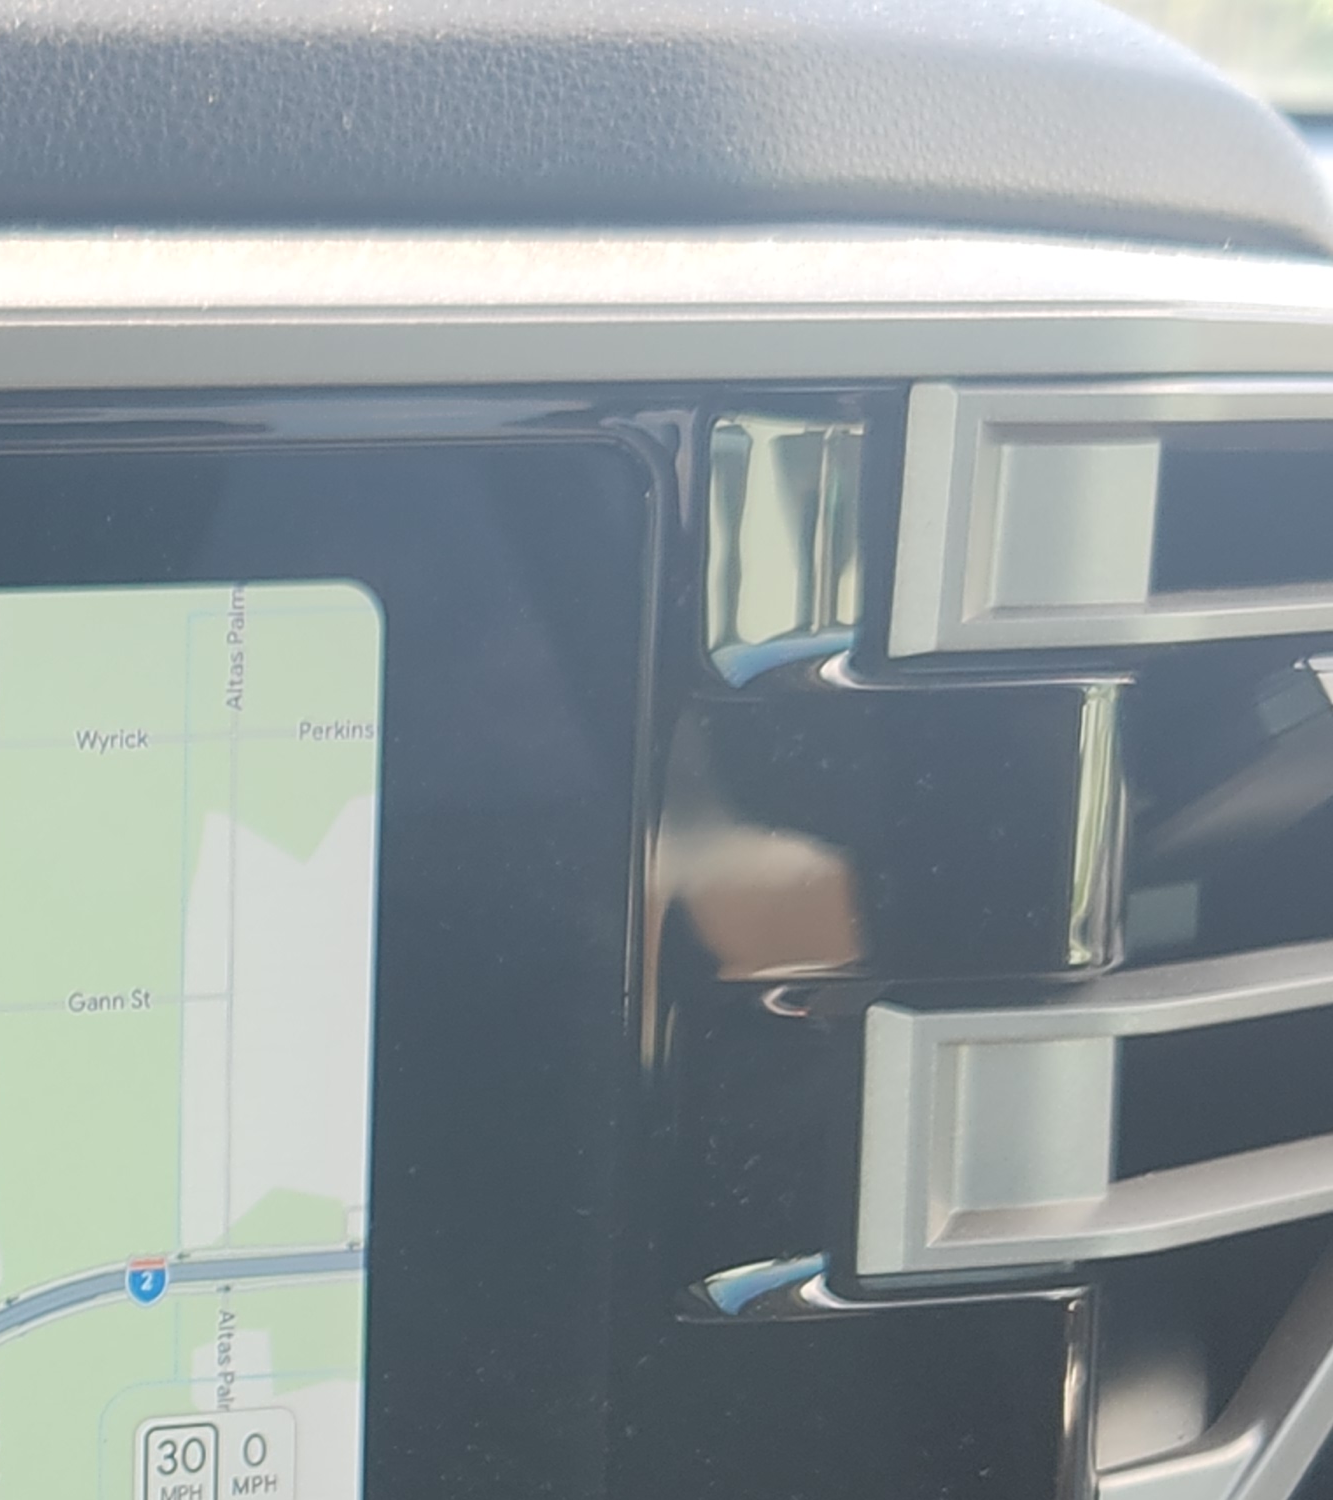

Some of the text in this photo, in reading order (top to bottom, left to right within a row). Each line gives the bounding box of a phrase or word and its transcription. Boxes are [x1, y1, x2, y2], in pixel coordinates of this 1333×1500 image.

[226, 651, 243, 711] Altas
[76, 730, 149, 754] Wyrick
[299, 721, 374, 740] Perkins
[68, 989, 151, 1012] Gann St
[140, 1271, 154, 1291] 2
[217, 1309, 235, 1366] Altas
[157, 1437, 206, 1475] 30
[243, 1433, 267, 1467] 0
[232, 1475, 278, 1496] MPH
